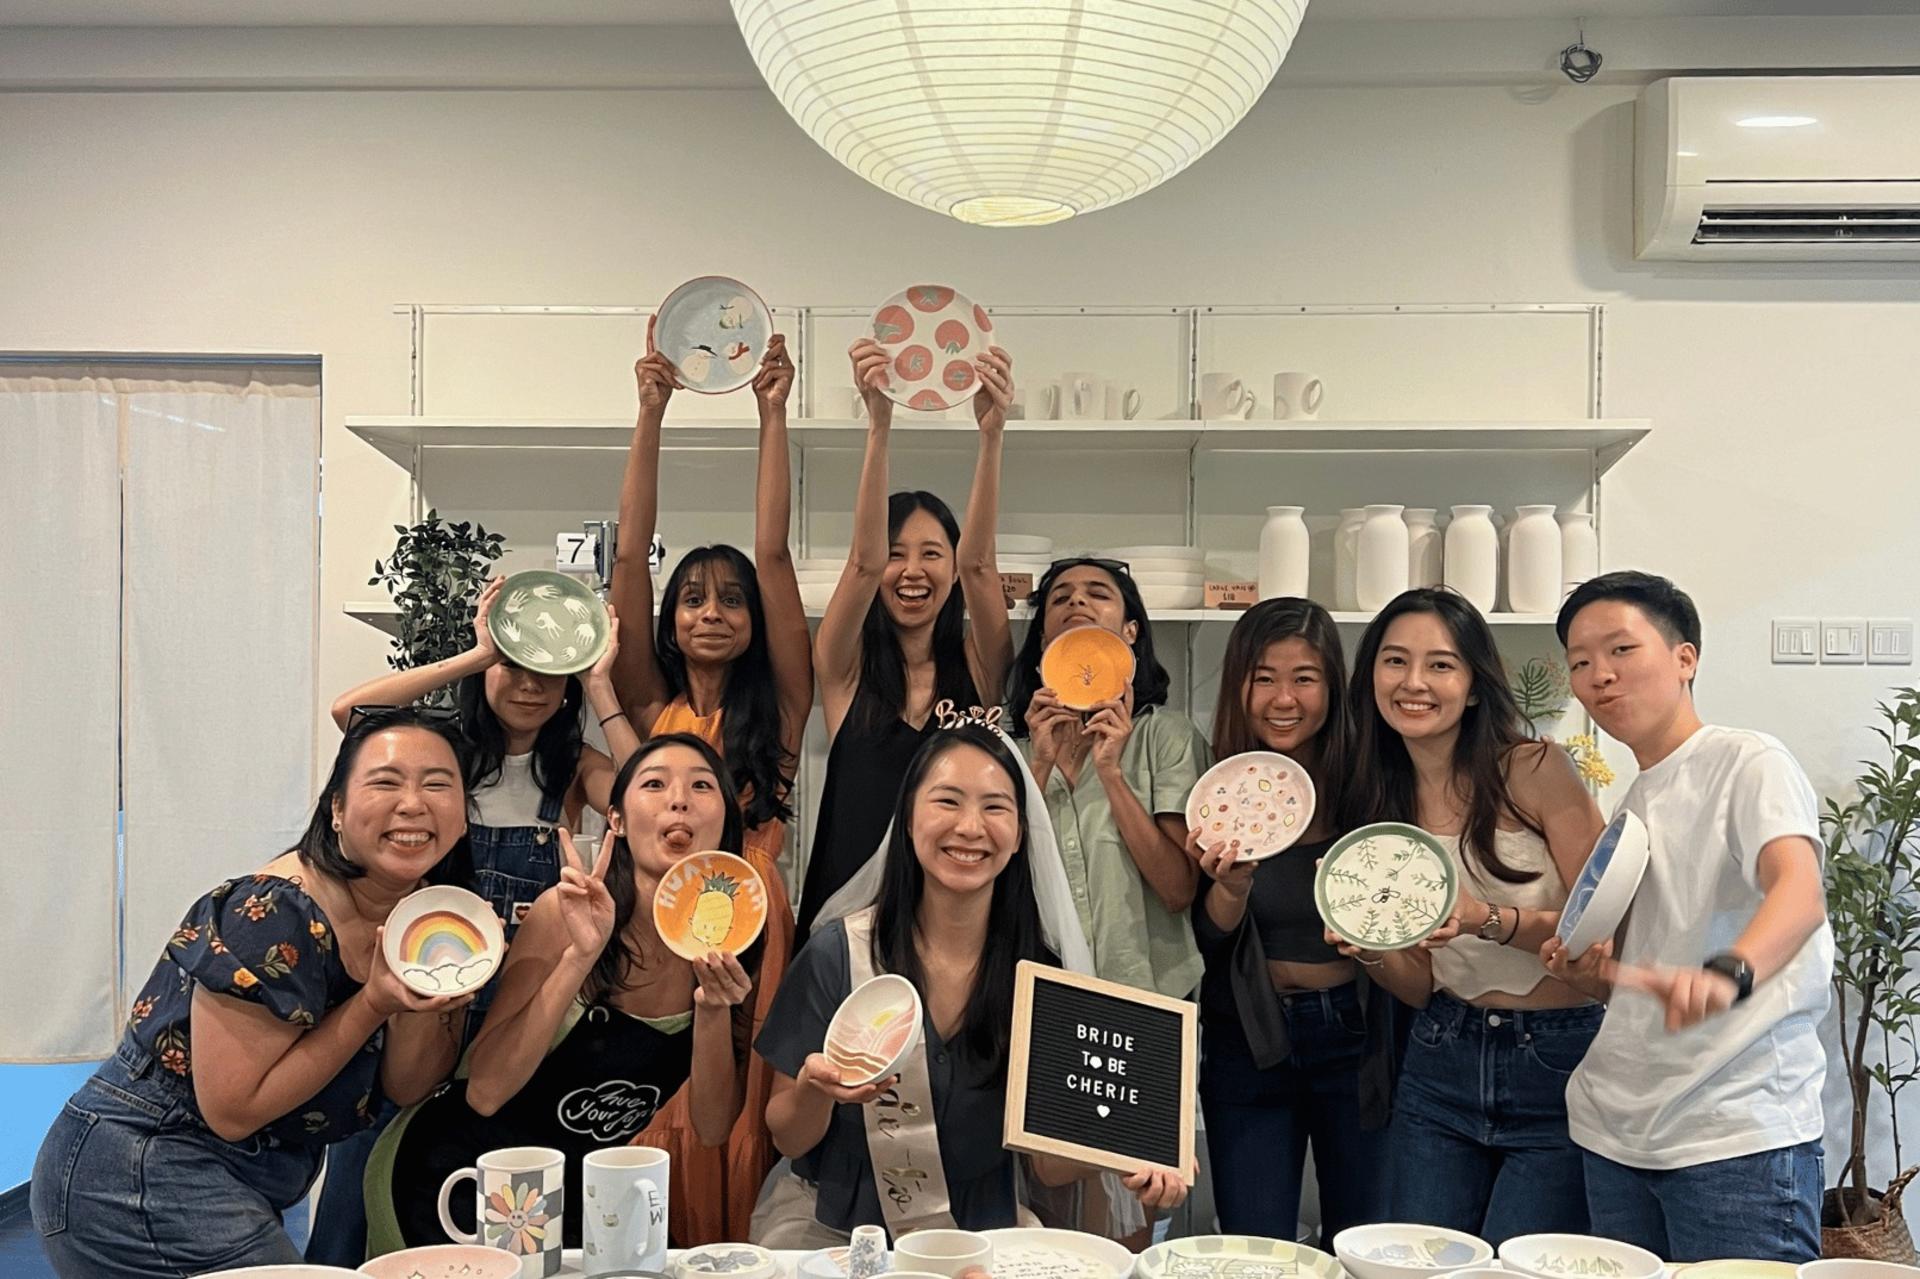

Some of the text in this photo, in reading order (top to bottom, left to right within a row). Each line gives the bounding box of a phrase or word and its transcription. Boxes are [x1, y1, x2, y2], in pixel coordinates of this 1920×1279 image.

[567, 538, 585, 563] 7
[1076, 1023, 1135, 1052] BRIDE
[1107, 1057, 1127, 1076] BE
[1066, 1073, 1139, 1105] CHERIE
